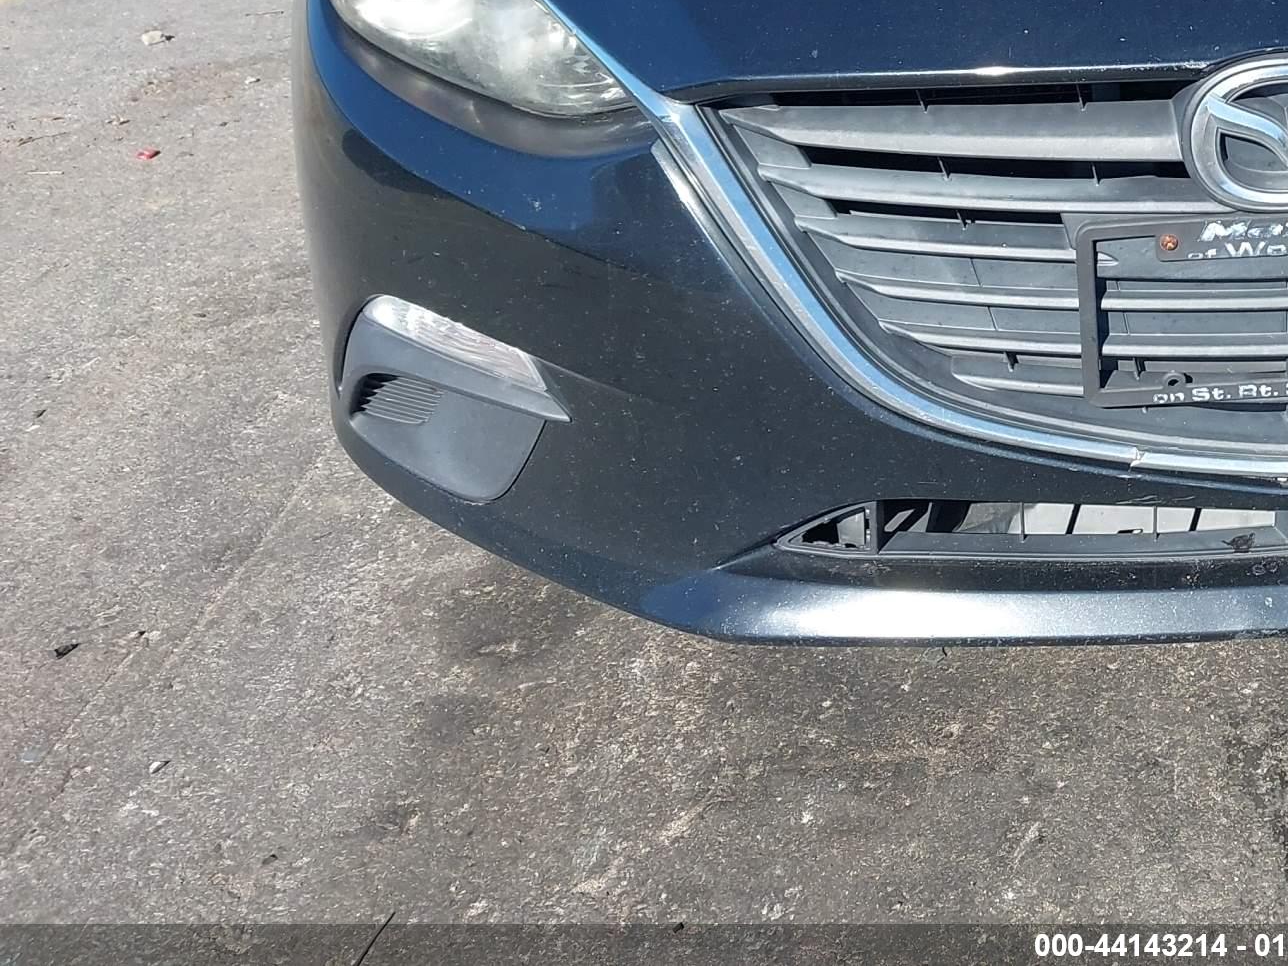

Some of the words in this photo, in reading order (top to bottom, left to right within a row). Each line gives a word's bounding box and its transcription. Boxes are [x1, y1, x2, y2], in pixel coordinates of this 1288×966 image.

[1188, 248, 1217, 259] of
[1153, 392, 1185, 403] on
[1192, 387, 1231, 401] St.
